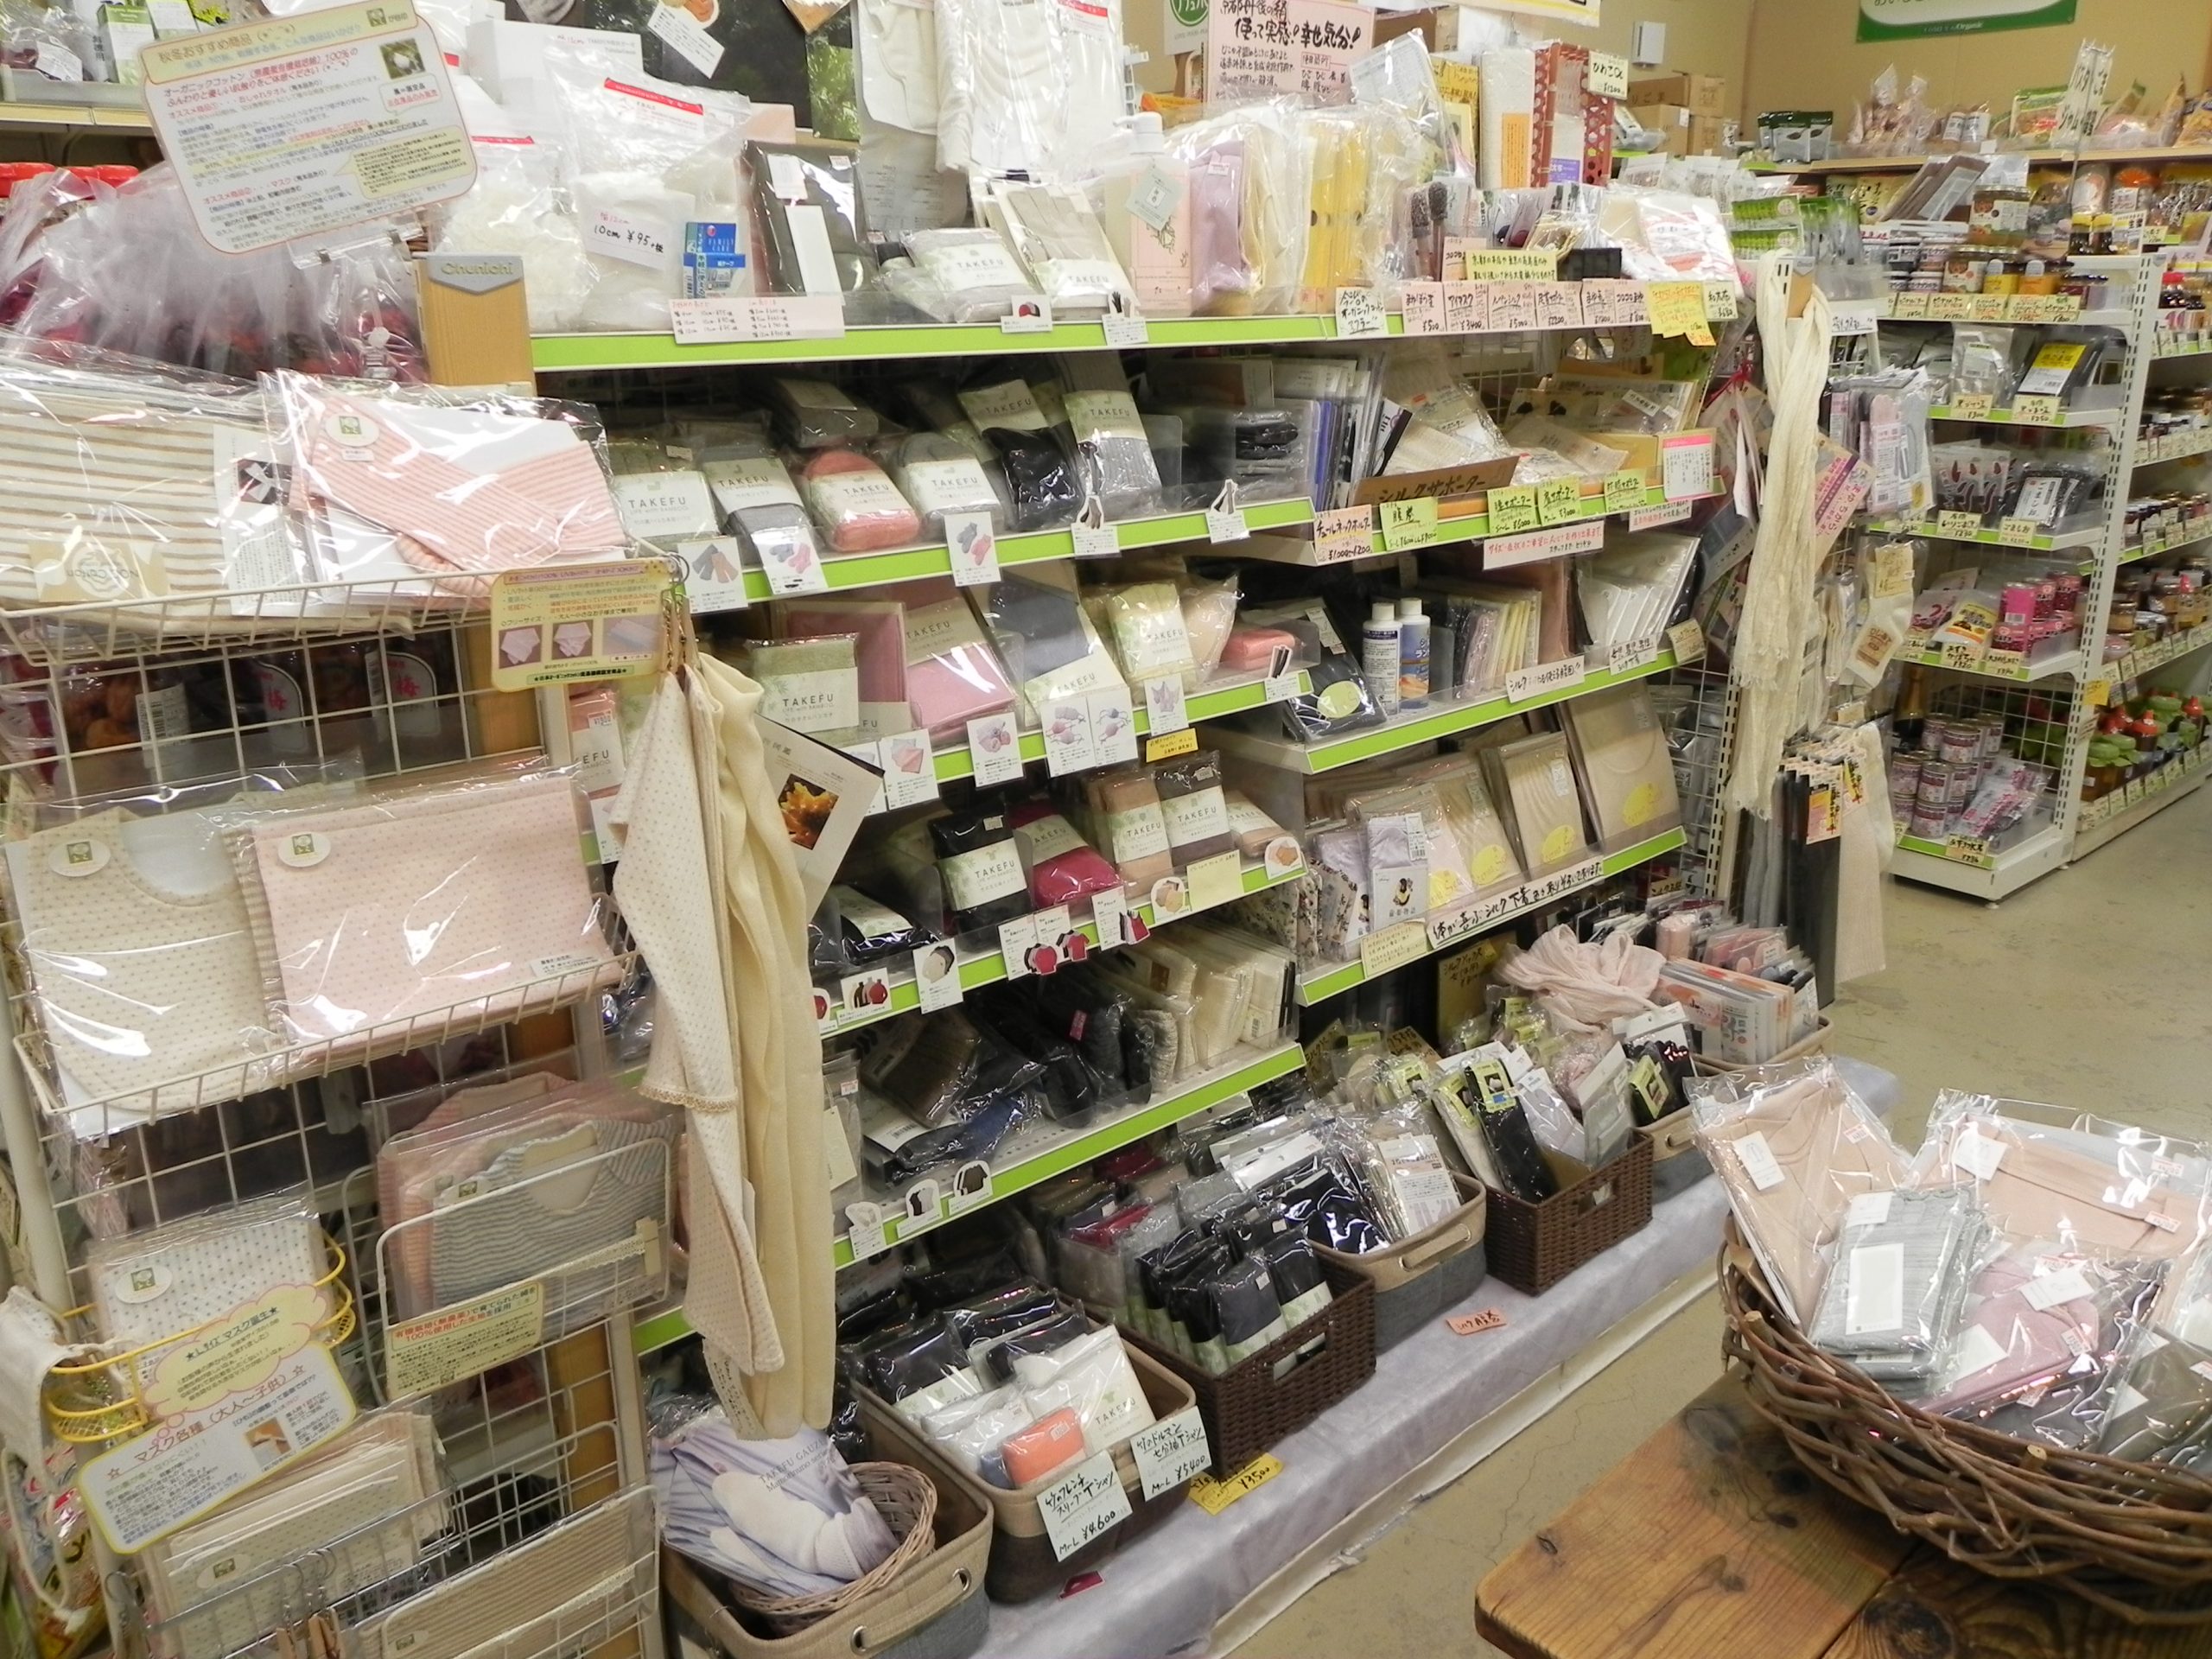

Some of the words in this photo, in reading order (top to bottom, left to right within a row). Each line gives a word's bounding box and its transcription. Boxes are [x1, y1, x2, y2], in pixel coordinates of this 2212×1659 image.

[440, 262, 514, 276] Chunichi
[957, 258, 1004, 270] TAKEFU
[1067, 275, 1110, 284] TAKEFU
[985, 397, 1033, 415] TAKEFU
[1089, 409, 1130, 418] TAKEFU
[717, 474, 770, 486] TAKEFU
[931, 476, 979, 488] TAKEFU
[843, 484, 890, 494] TAKEFU
[628, 497, 687, 509] TAKEFU
[906, 620, 951, 639] TAKEFU
[1147, 627, 1185, 640] TAKEFU
[1058, 673, 1096, 693] TAKEFU
[782, 693, 835, 708] TAKEFU
[1178, 804, 1217, 823] TAKEFU
[1229, 810, 1262, 822] TAKEFU
[1126, 821, 1162, 837] TAKEFU
[974, 859, 1016, 880] TAKEFU
[760, 1457, 795, 1484] TAKEFU
